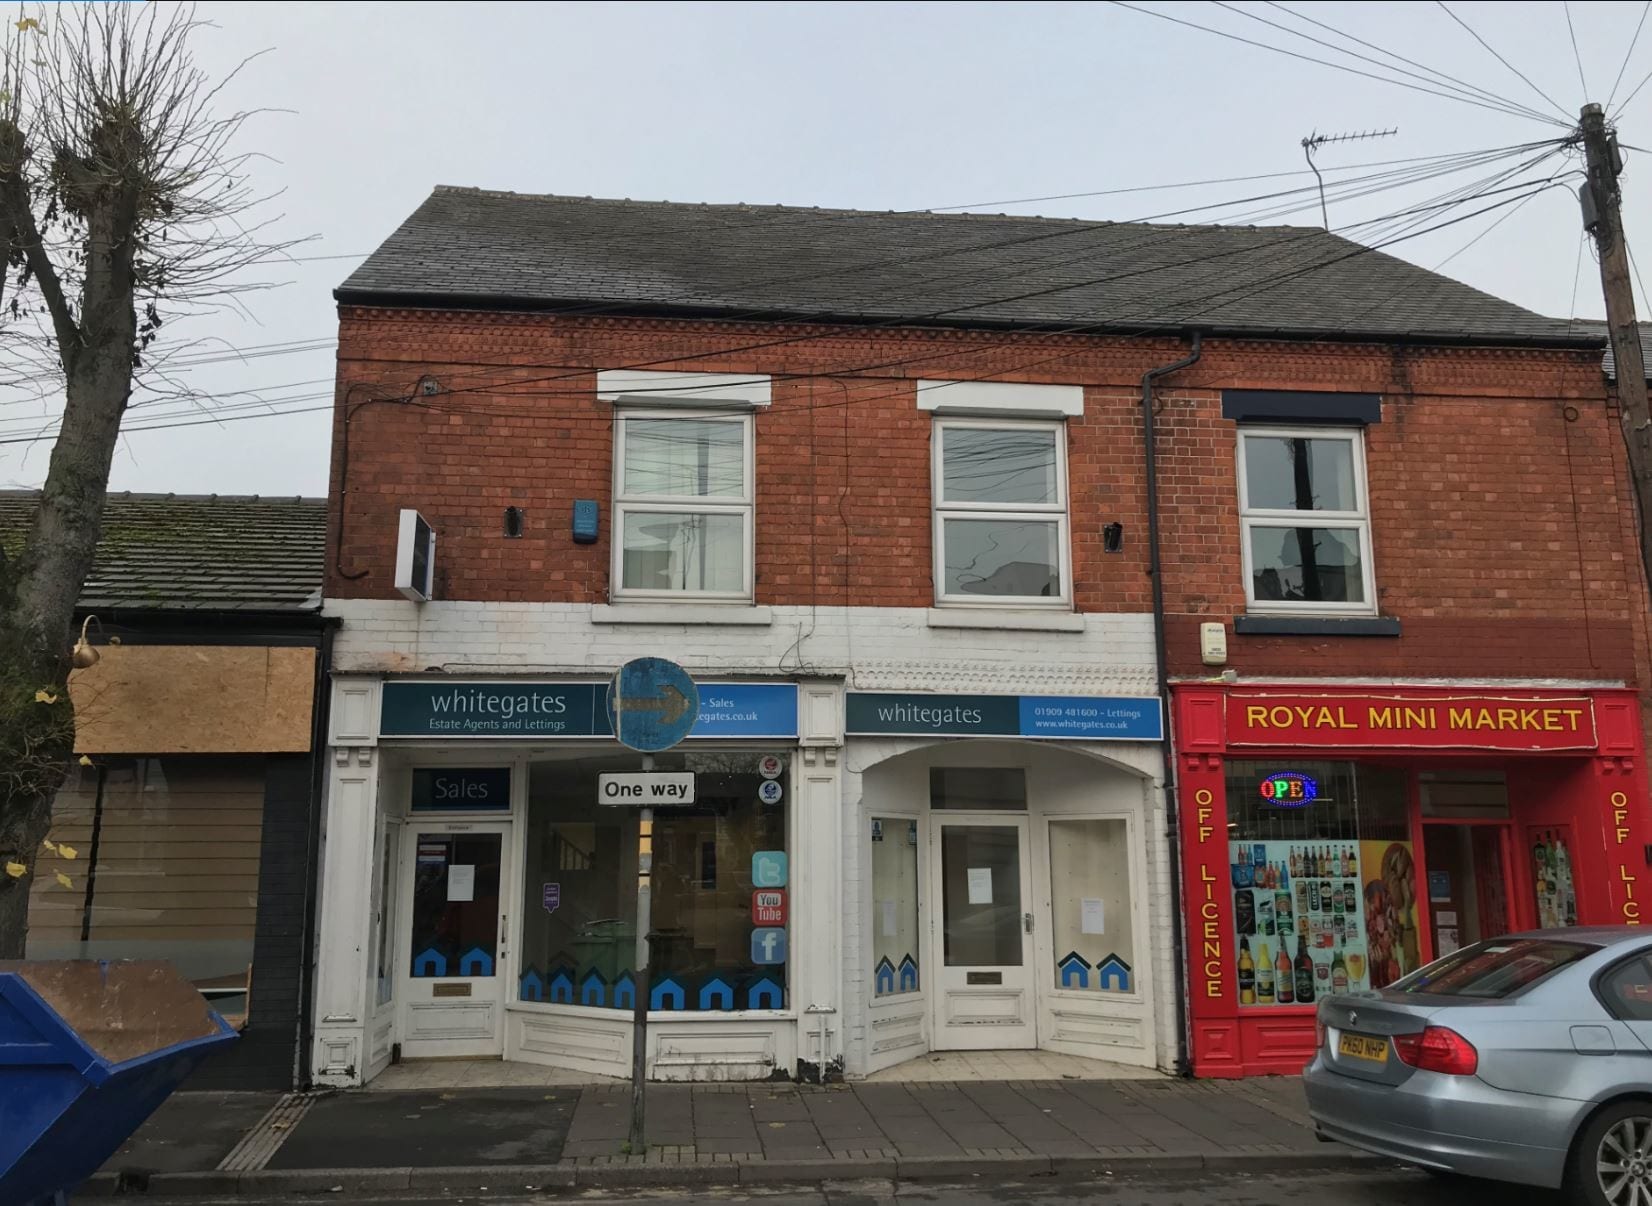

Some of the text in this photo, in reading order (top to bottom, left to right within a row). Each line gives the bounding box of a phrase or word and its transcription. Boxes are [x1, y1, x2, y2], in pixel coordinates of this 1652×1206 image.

[431, 689, 566, 719] whitegates
[709, 697, 735, 708] Sales
[698, 711, 758, 723] egates.co.uk
[878, 703, 982, 728] whitegates
[1034, 707, 1063, 717] 01909
[1065, 708, 1098, 718] 481600
[1107, 709, 1141, 720] Lettings
[1246, 705, 1582, 732] ROYAL MINI MARKET
[429, 718, 566, 732] Estate Agents and Lettings
[1035, 719, 1128, 730] www.whitegates.co.uk
[435, 777, 489, 799] Sales
[604, 781, 688, 800] One way
[1260, 780, 1317, 798] OPEN
[1610, 791, 1640, 926] OFF LIC
[760, 894, 779, 906] You
[1195, 789, 1222, 997] OFF LICENCE
[757, 907, 782, 921] Tube
